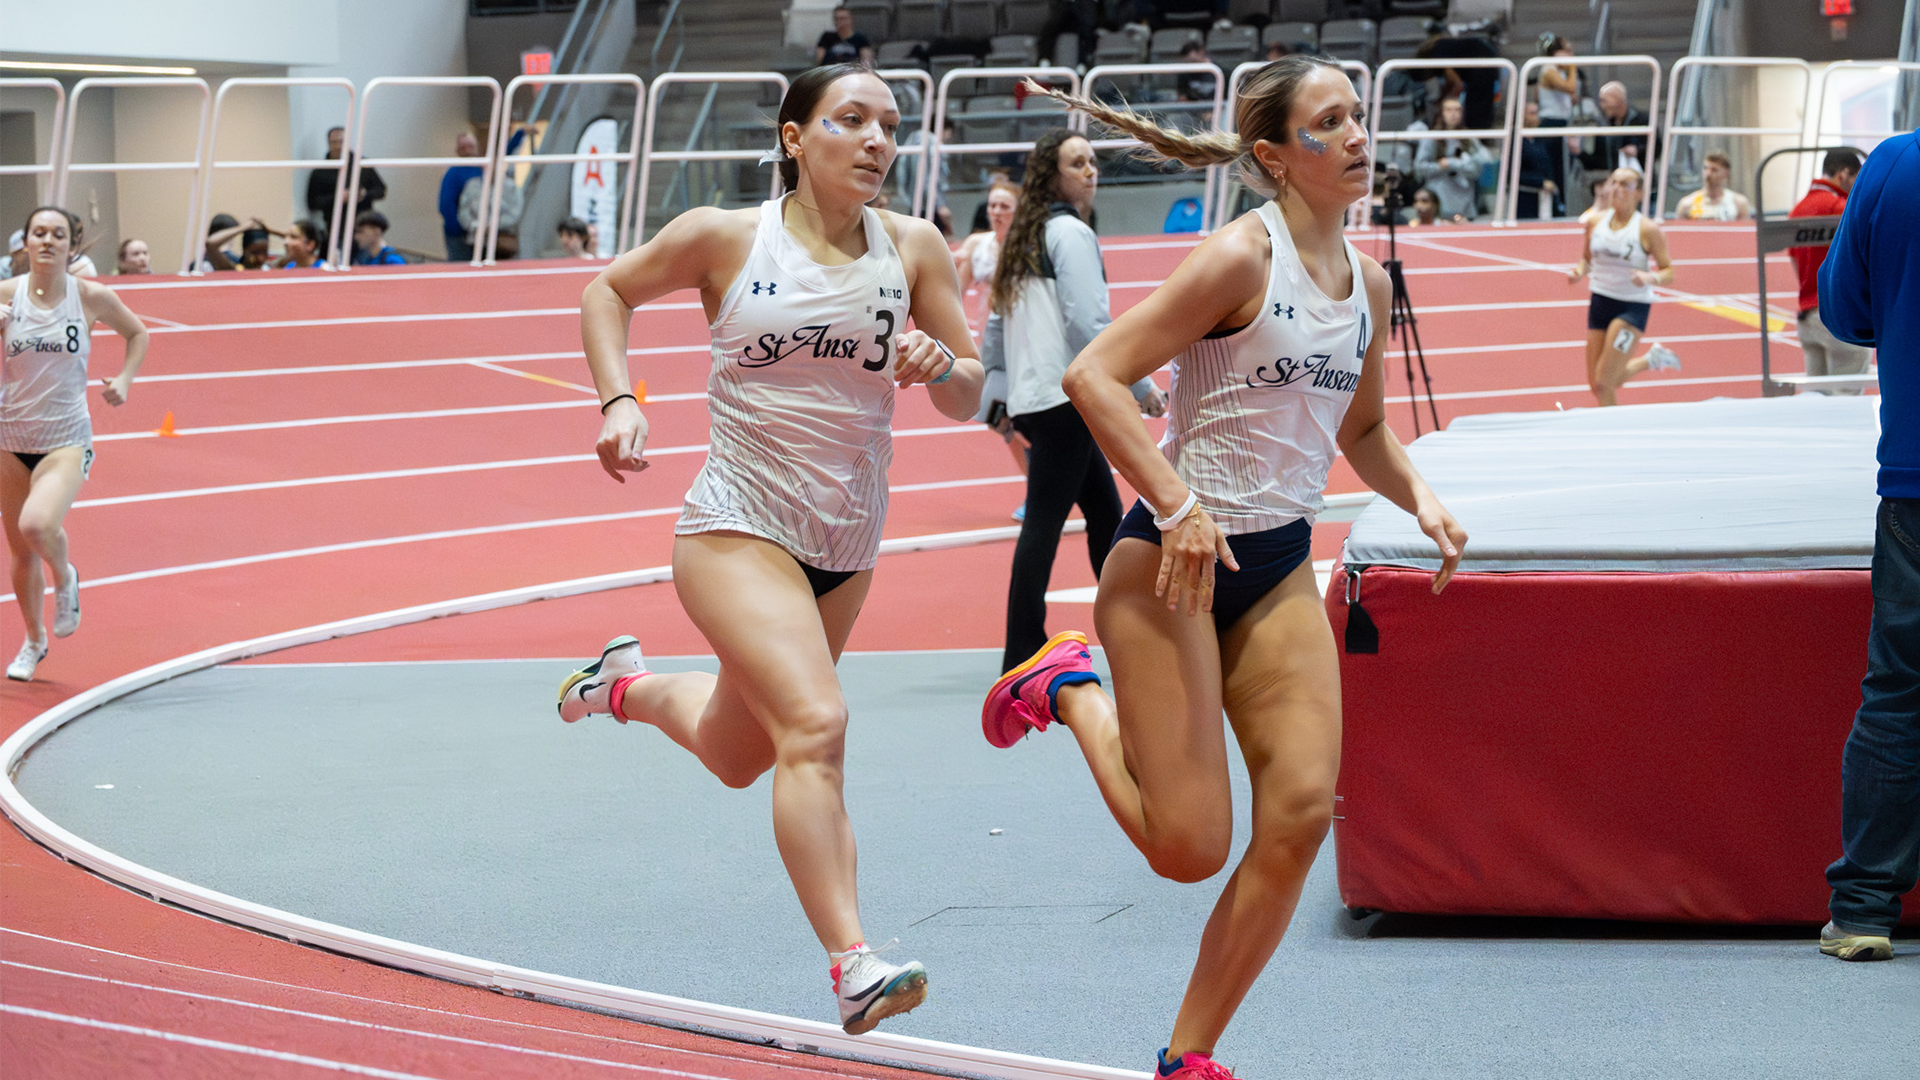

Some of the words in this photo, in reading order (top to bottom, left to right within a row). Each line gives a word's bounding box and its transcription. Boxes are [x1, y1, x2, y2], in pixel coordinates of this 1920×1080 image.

[879, 286, 902, 300] NE10
[66, 325, 80, 353] 8
[738, 333, 787, 368] St
[862, 309, 895, 372] 3
[1246, 357, 1300, 389] St
